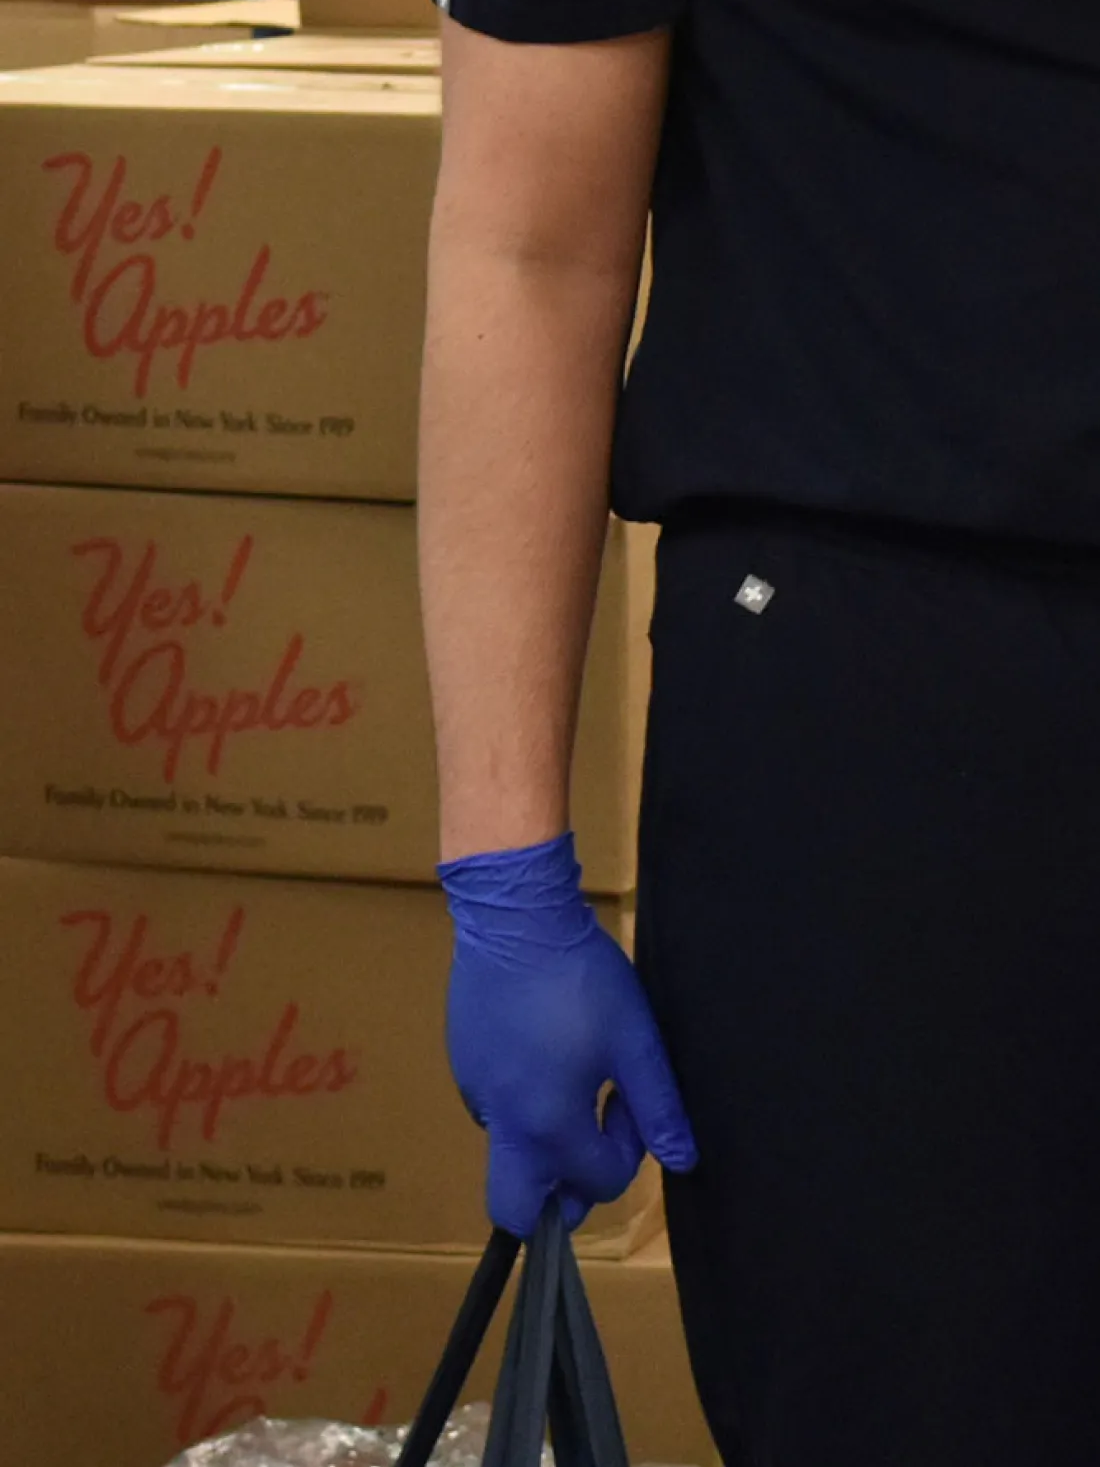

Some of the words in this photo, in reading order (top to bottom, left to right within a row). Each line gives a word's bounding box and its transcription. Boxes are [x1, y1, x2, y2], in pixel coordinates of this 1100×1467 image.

[41, 145, 222, 304] Yes!
[84, 243, 328, 399] Apples
[71, 534, 253, 685] Yes!
[108, 632, 356, 785] Apples
[60, 905, 244, 1059] Yes!
[104, 1001, 357, 1151] Apples
[144, 1289, 333, 1445] Yes!
